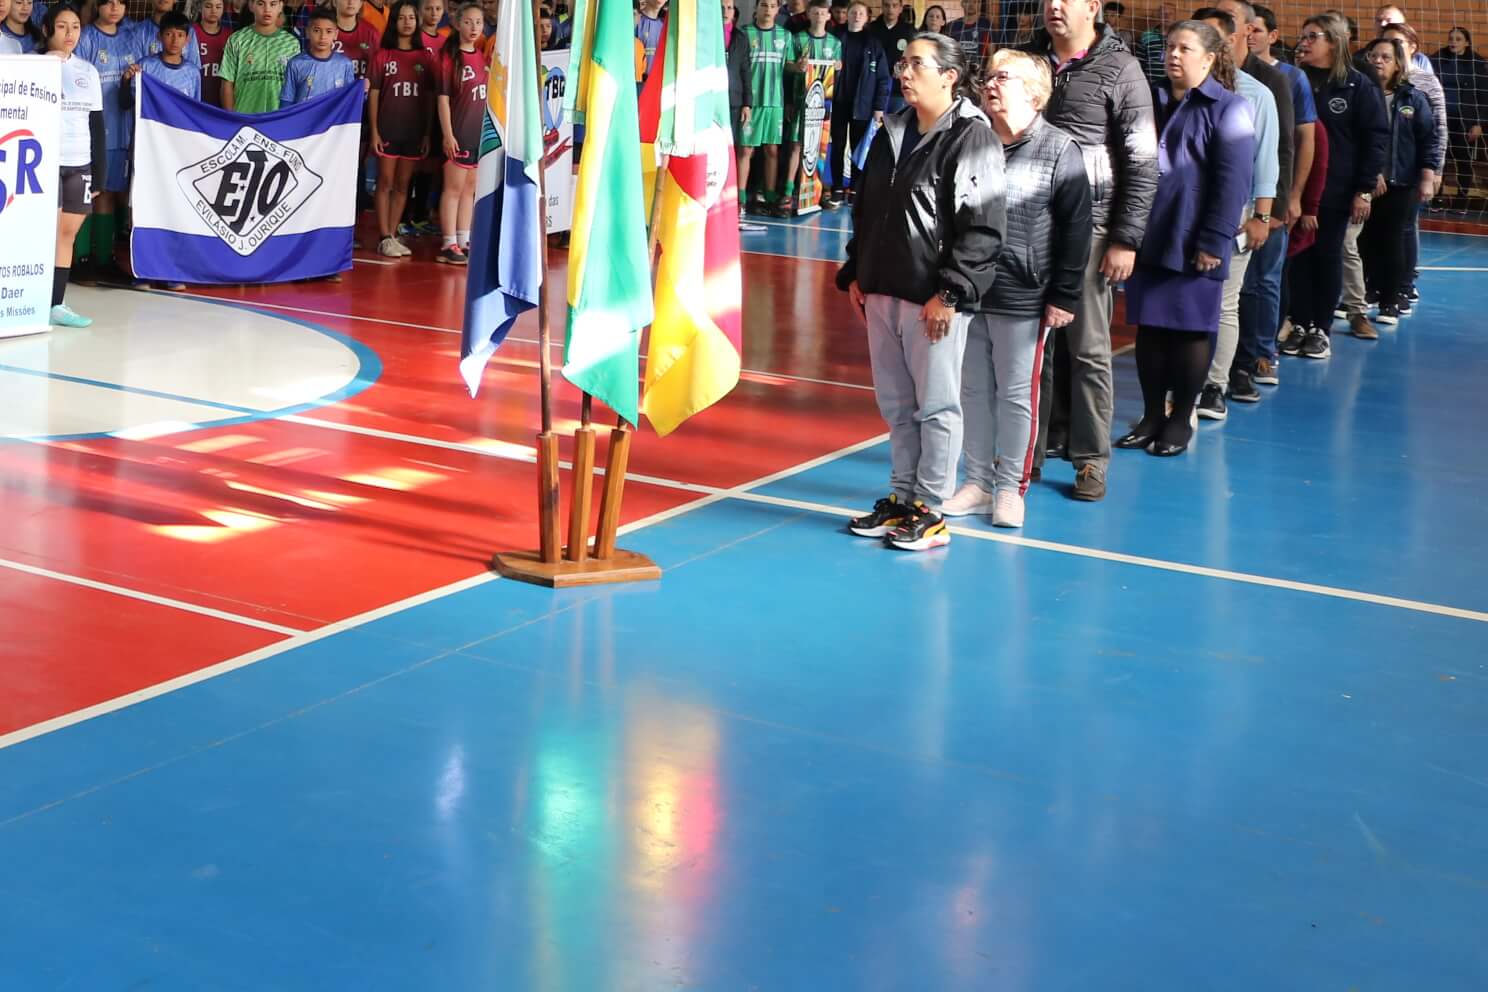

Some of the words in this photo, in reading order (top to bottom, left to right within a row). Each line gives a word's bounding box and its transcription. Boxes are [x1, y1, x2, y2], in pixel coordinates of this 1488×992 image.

[202, 63, 220, 77] TB
[18, 81, 28, 96] de
[30, 82, 58, 104] Ensino
[472, 84, 487, 101] TB
[200, 142, 241, 174] ESCOLA
[195, 199, 237, 245] EVILASIO
[248, 202, 292, 248] OURIQUE
[12, 263, 45, 278] ROBALOS
[1, 287, 24, 300] Daer
